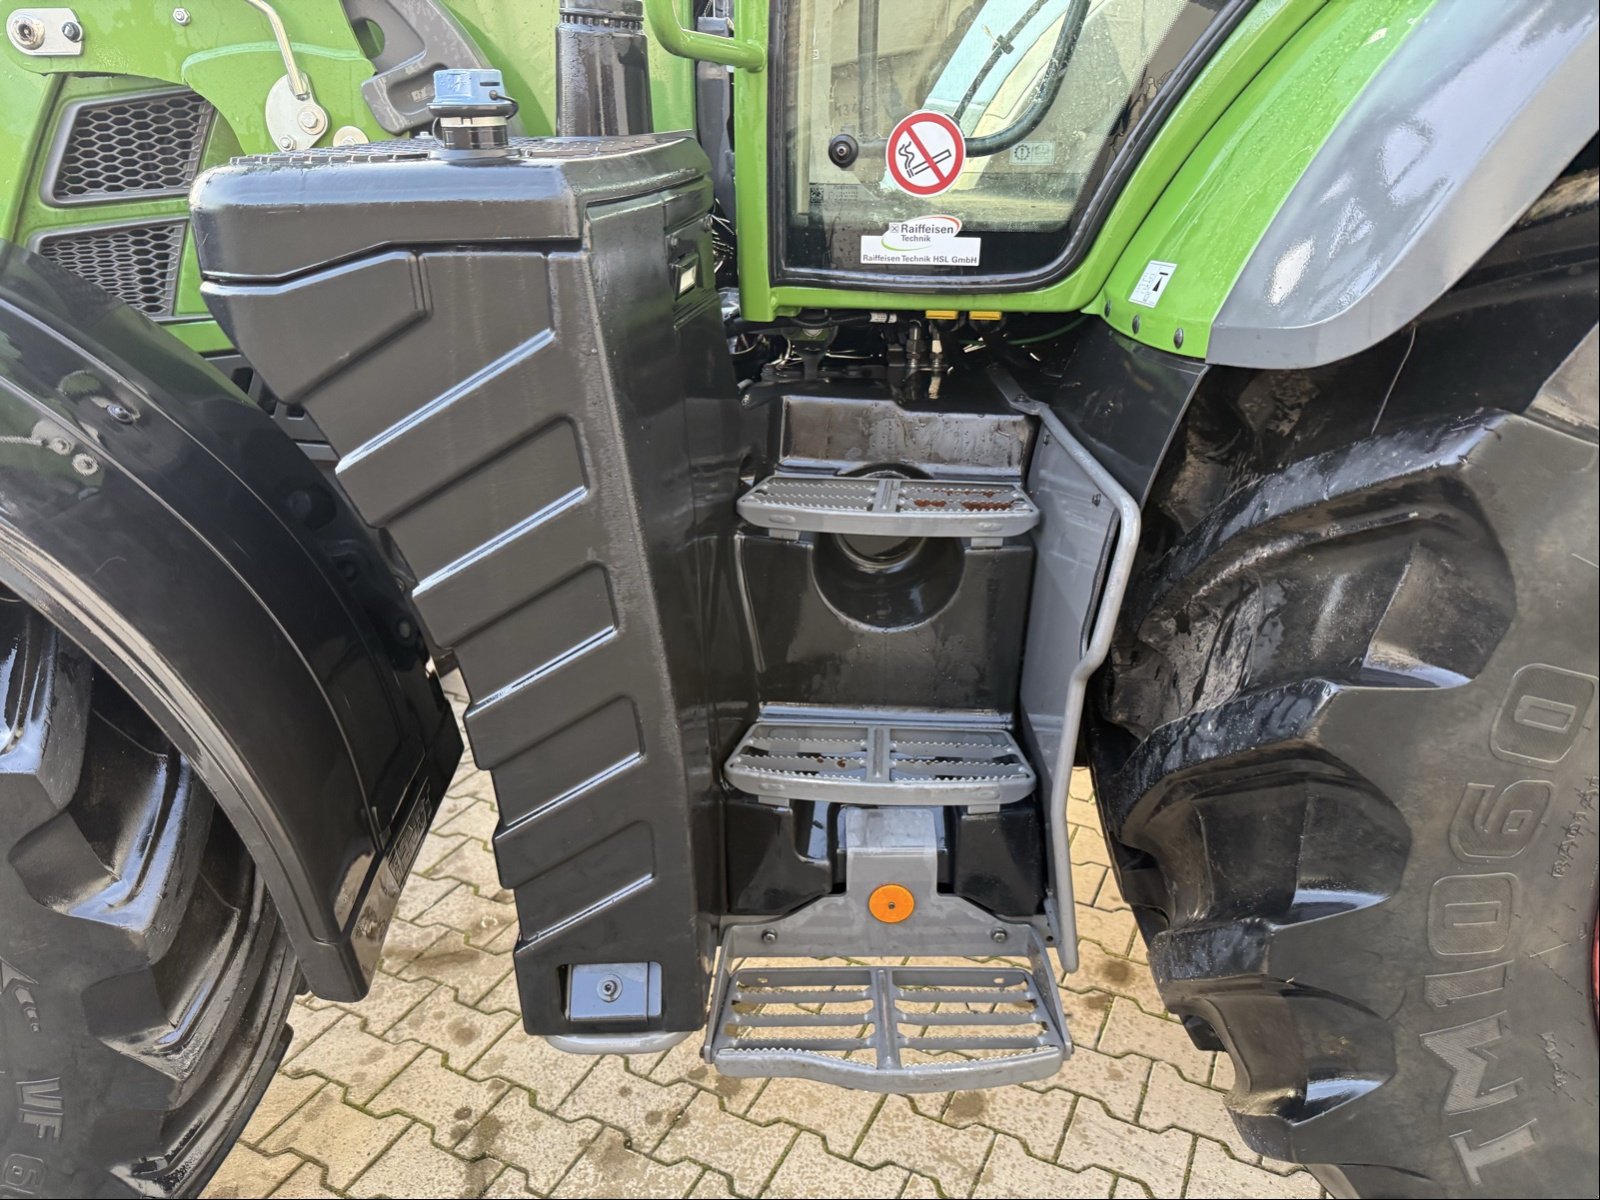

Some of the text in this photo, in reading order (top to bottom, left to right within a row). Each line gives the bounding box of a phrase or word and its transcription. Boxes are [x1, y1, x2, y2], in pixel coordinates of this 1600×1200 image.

[900, 223, 955, 234] Raiffeisen
[901, 234, 931, 242] Technik
[862, 254, 978, 264] Raiffeisen Technik HSL GmbH
